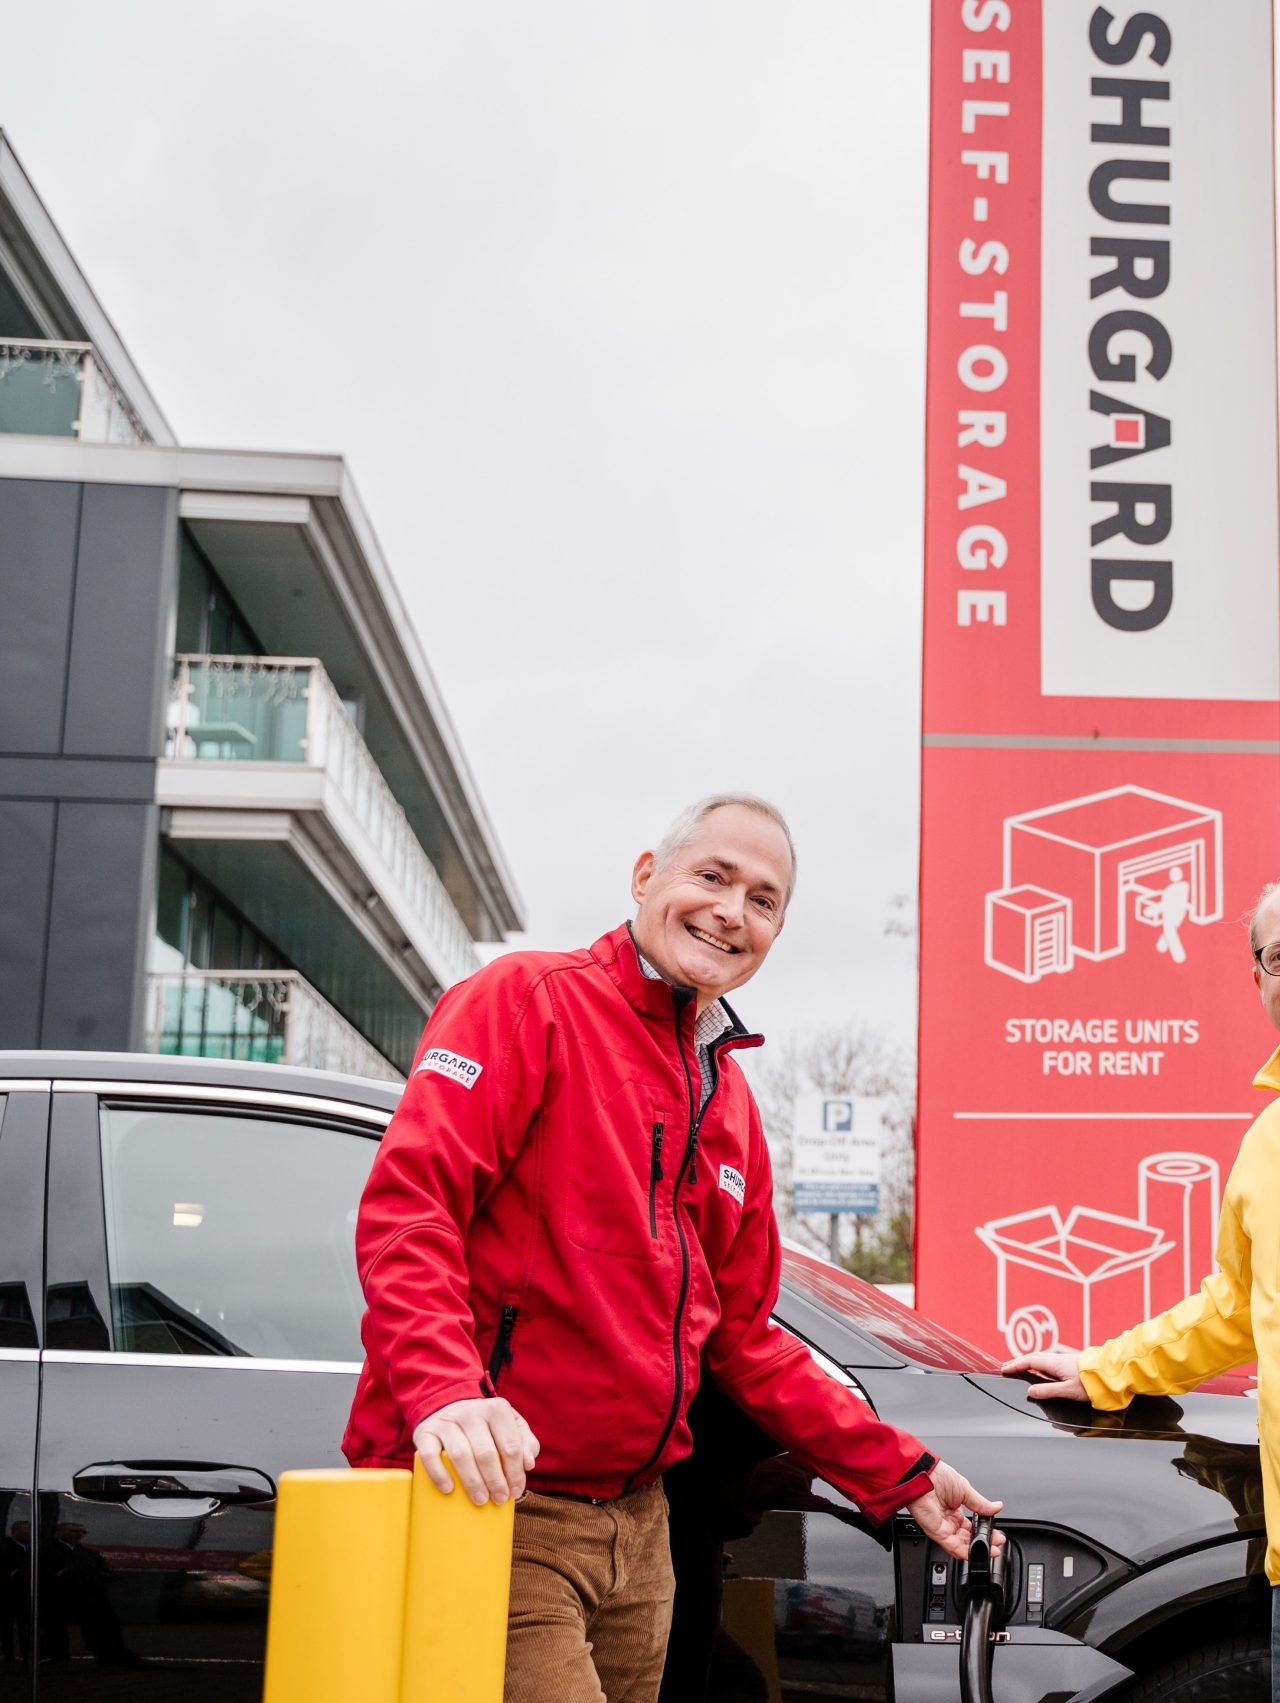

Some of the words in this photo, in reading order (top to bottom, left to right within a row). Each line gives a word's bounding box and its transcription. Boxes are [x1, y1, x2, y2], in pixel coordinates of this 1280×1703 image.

[956, 0, 1011, 626] SELF-STORAGE
[1088, 6, 1173, 633] SHURGARD
[1005, 1018, 1119, 1044] STORAGE
[1125, 1019, 1200, 1045] UNITS
[423, 1051, 477, 1076] URGARD
[1042, 1051, 1092, 1076] FOR
[1098, 1051, 1165, 1076] RENT
